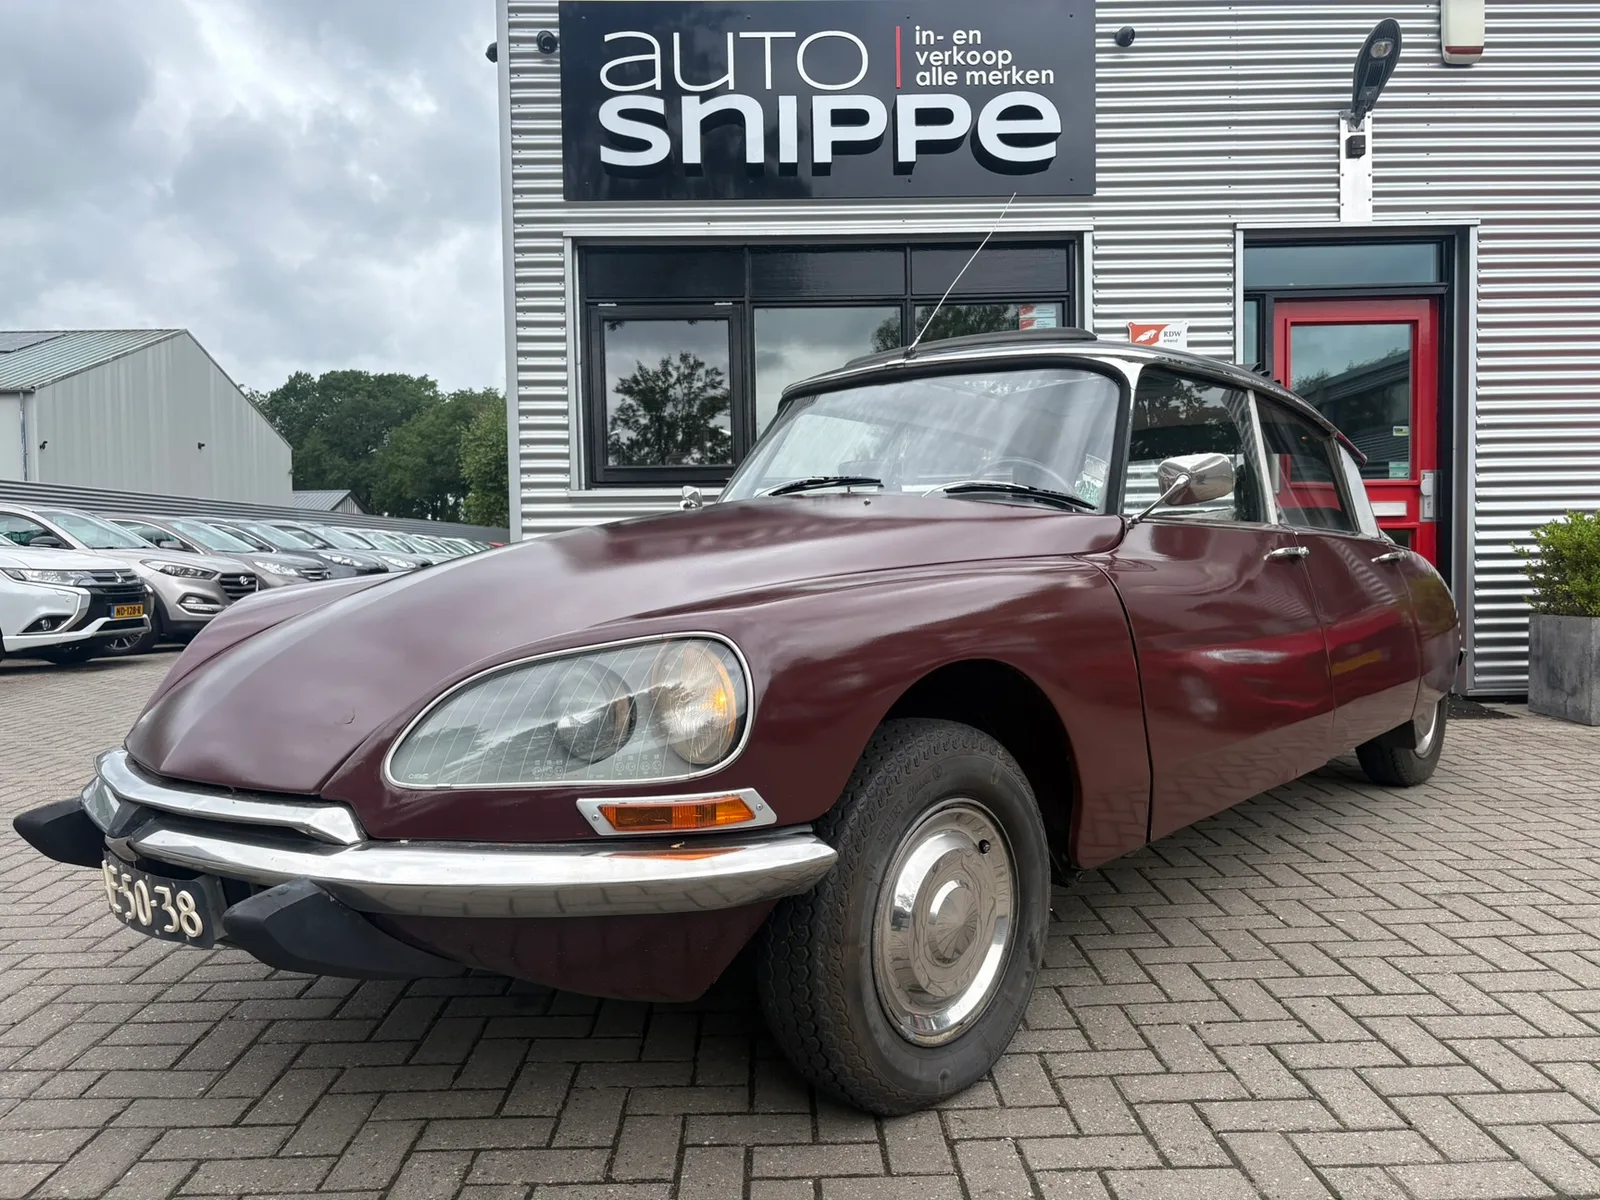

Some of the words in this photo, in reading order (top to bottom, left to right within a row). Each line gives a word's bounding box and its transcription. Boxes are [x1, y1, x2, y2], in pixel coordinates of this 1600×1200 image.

[914, 26, 944, 45] in-
[952, 29, 982, 45] en
[914, 46, 1013, 67] verkoop
[915, 66, 958, 87] alle
[965, 65, 1055, 86] merken
[116, 606, 142, 616] ND-128-R
